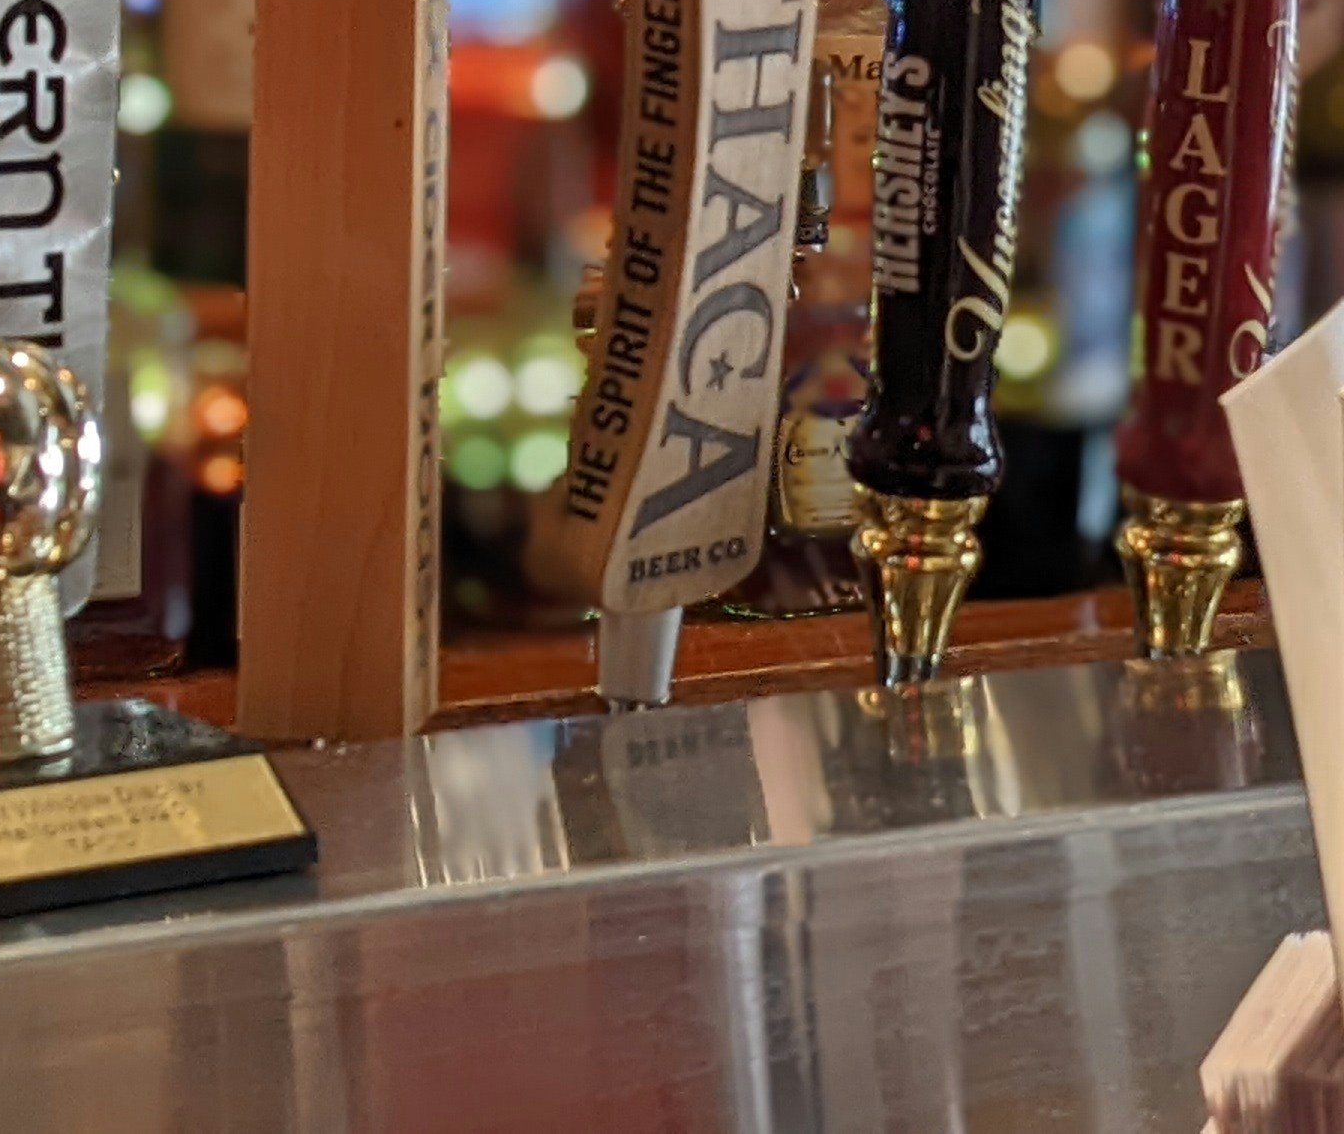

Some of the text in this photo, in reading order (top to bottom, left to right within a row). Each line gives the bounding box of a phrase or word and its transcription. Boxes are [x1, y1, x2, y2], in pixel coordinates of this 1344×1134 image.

[630, 130, 675, 215] THE
[875, 52, 932, 294] HERSHEY'S
[1159, 38, 1231, 385] LAGER
[624, 223, 665, 285] OF
[591, 292, 653, 436] SPIRIT
[567, 442, 619, 523] THE
[628, 546, 702, 583] BEER
